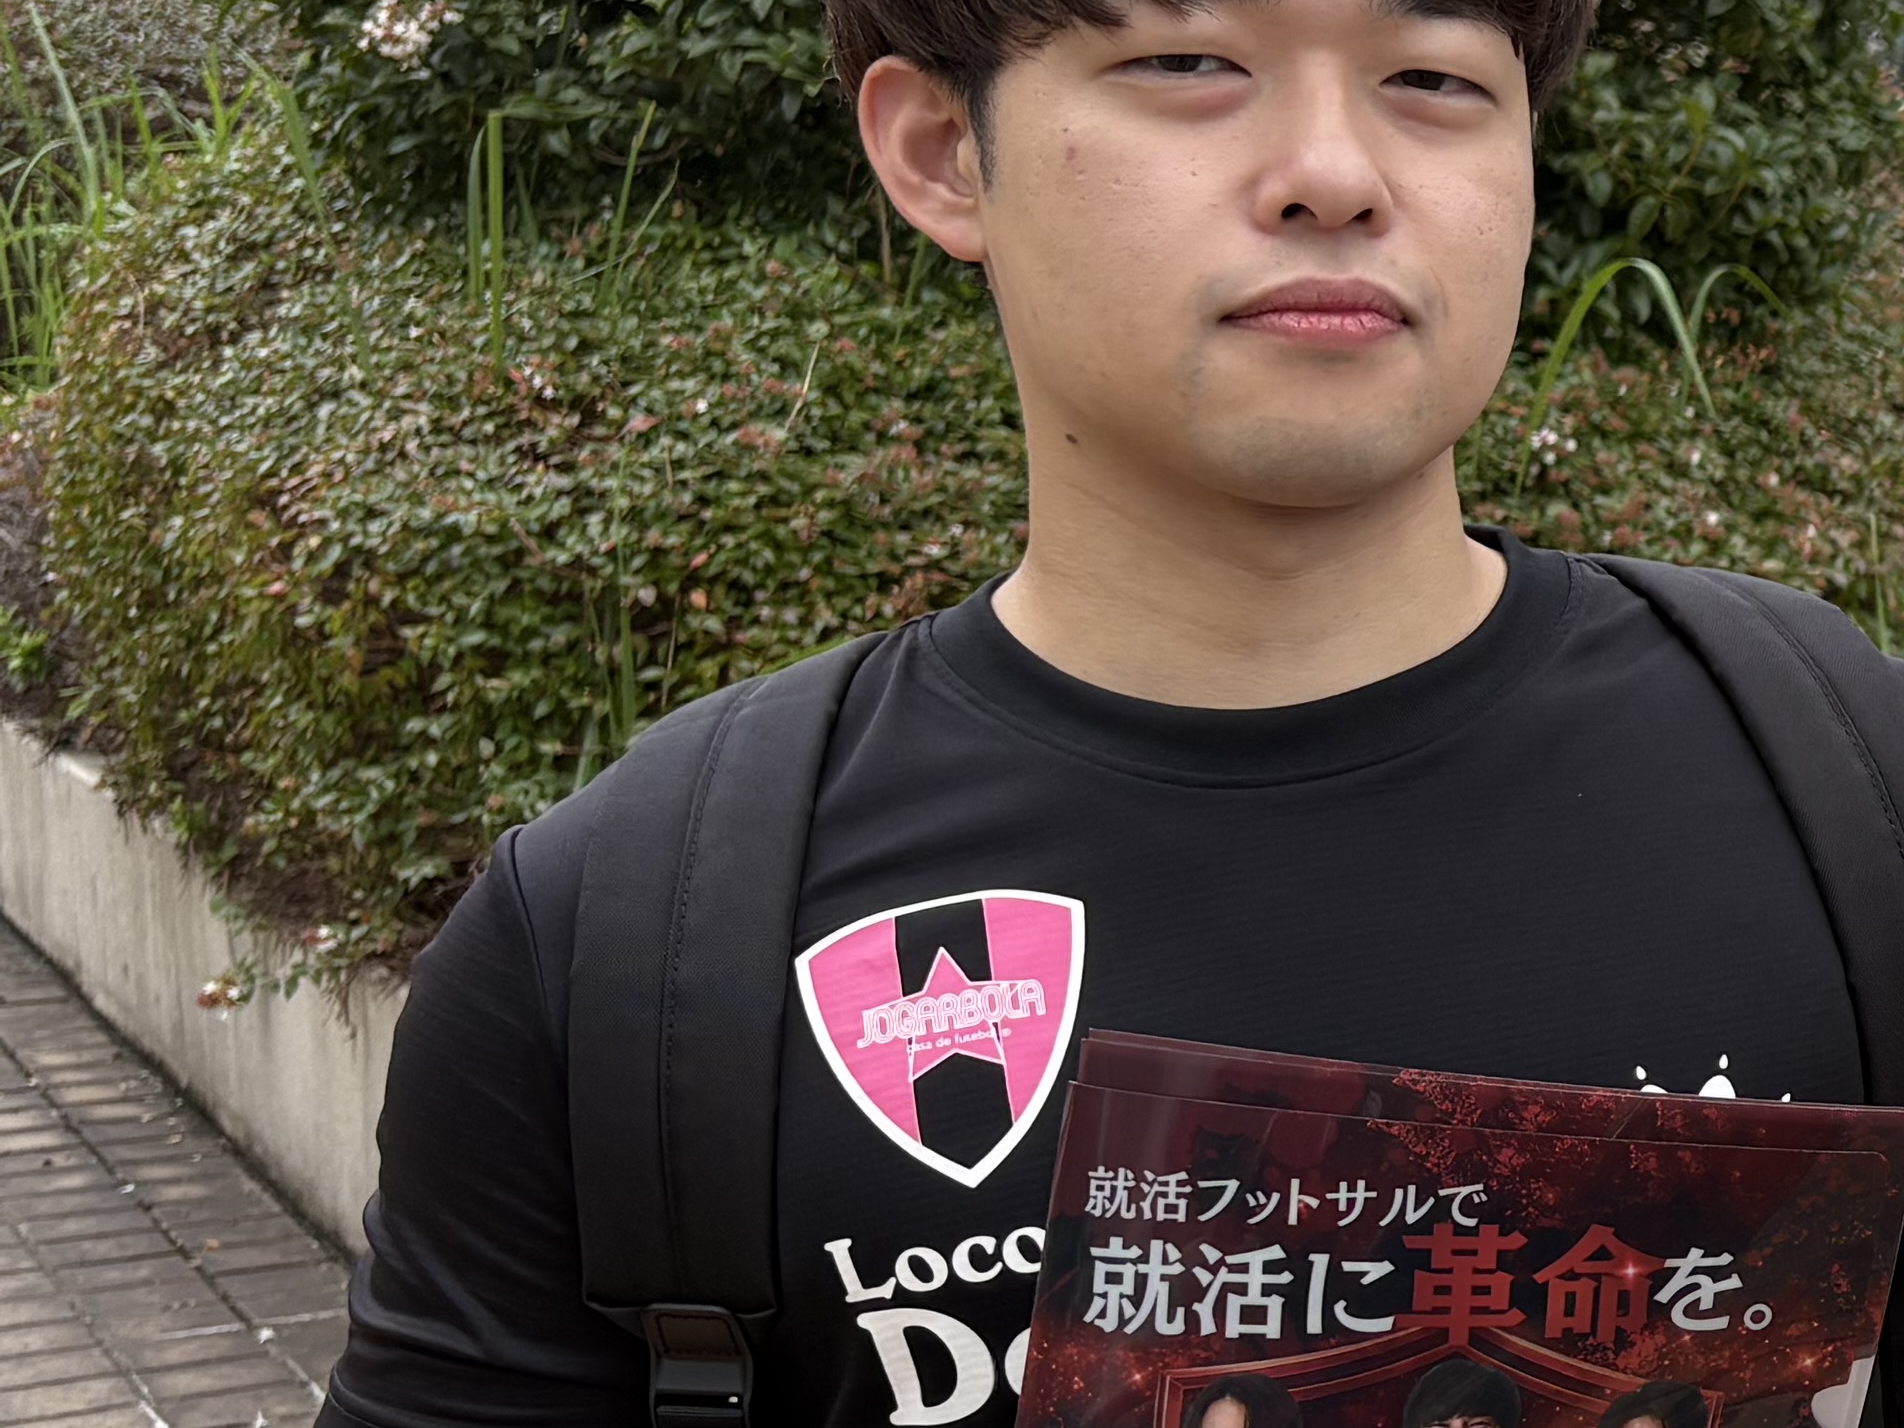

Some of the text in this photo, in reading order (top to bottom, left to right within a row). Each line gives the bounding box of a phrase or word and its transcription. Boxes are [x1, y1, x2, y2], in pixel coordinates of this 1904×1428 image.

[857, 979, 1047, 1049] JOGARBOLA
[1085, 1165, 1489, 1228] 就活フットサルで
[1082, 1223, 1773, 1344] 就活に革命を。
